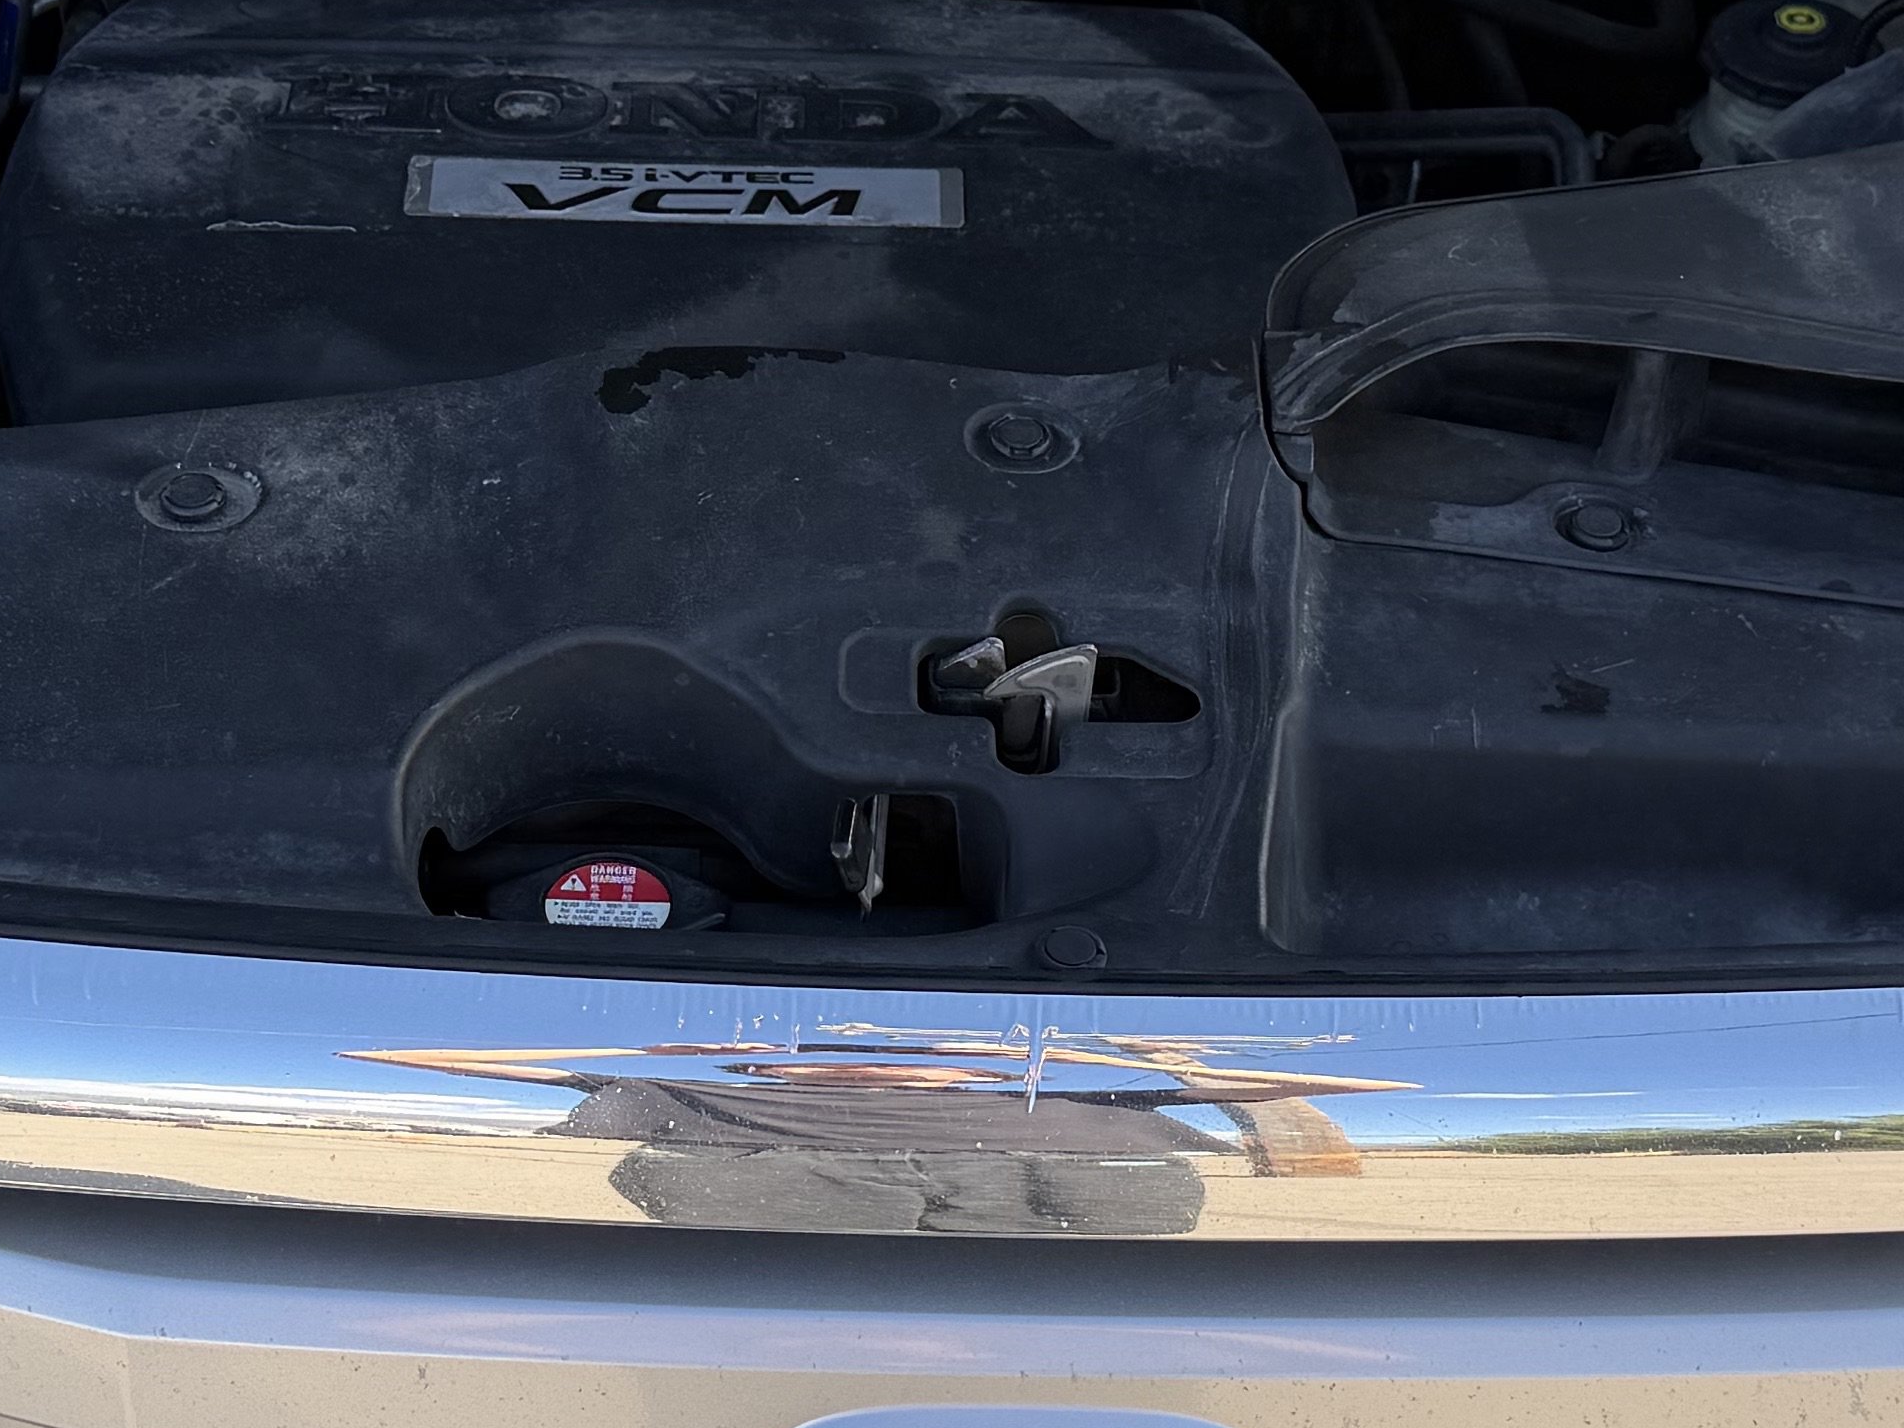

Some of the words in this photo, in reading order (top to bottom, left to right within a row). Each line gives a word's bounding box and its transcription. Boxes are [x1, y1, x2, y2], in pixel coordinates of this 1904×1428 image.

[262, 72, 1114, 149] HONDA
[559, 165, 633, 183] 3.5
[503, 182, 864, 217] VCM
